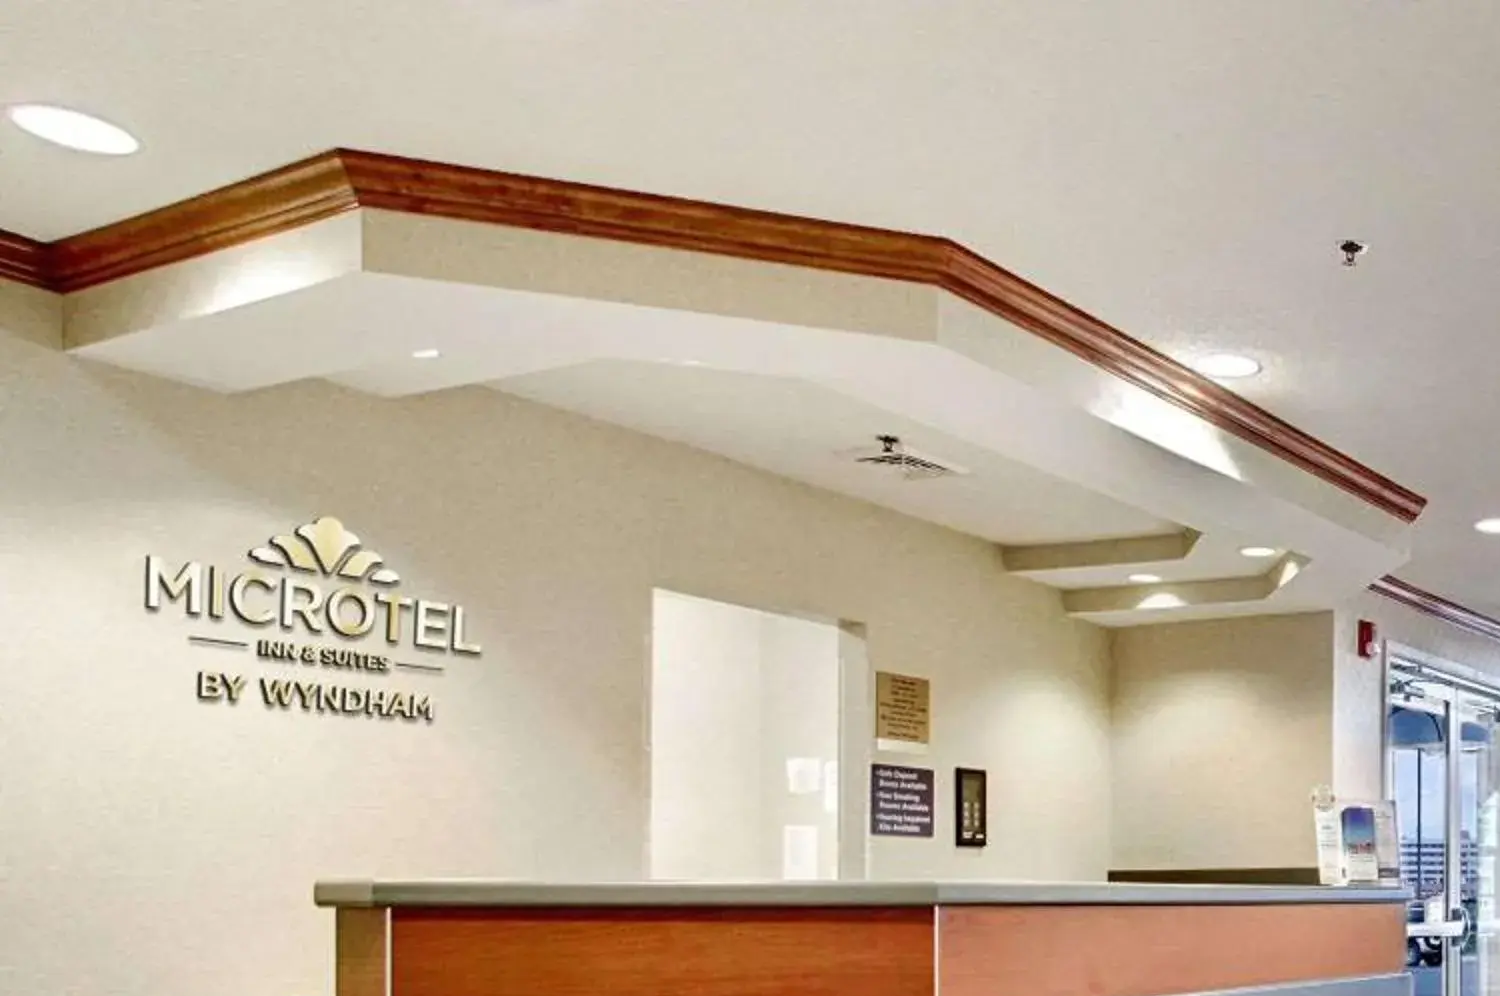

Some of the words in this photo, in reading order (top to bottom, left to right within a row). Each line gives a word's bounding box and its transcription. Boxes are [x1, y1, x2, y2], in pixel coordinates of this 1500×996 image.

[144, 555, 482, 656] MICROTEL
[257, 639, 296, 661] INN
[301, 646, 314, 663] &
[320, 648, 389, 671] SUITES
[197, 671, 245, 704] BY
[259, 677, 434, 721] WYNDHAM
